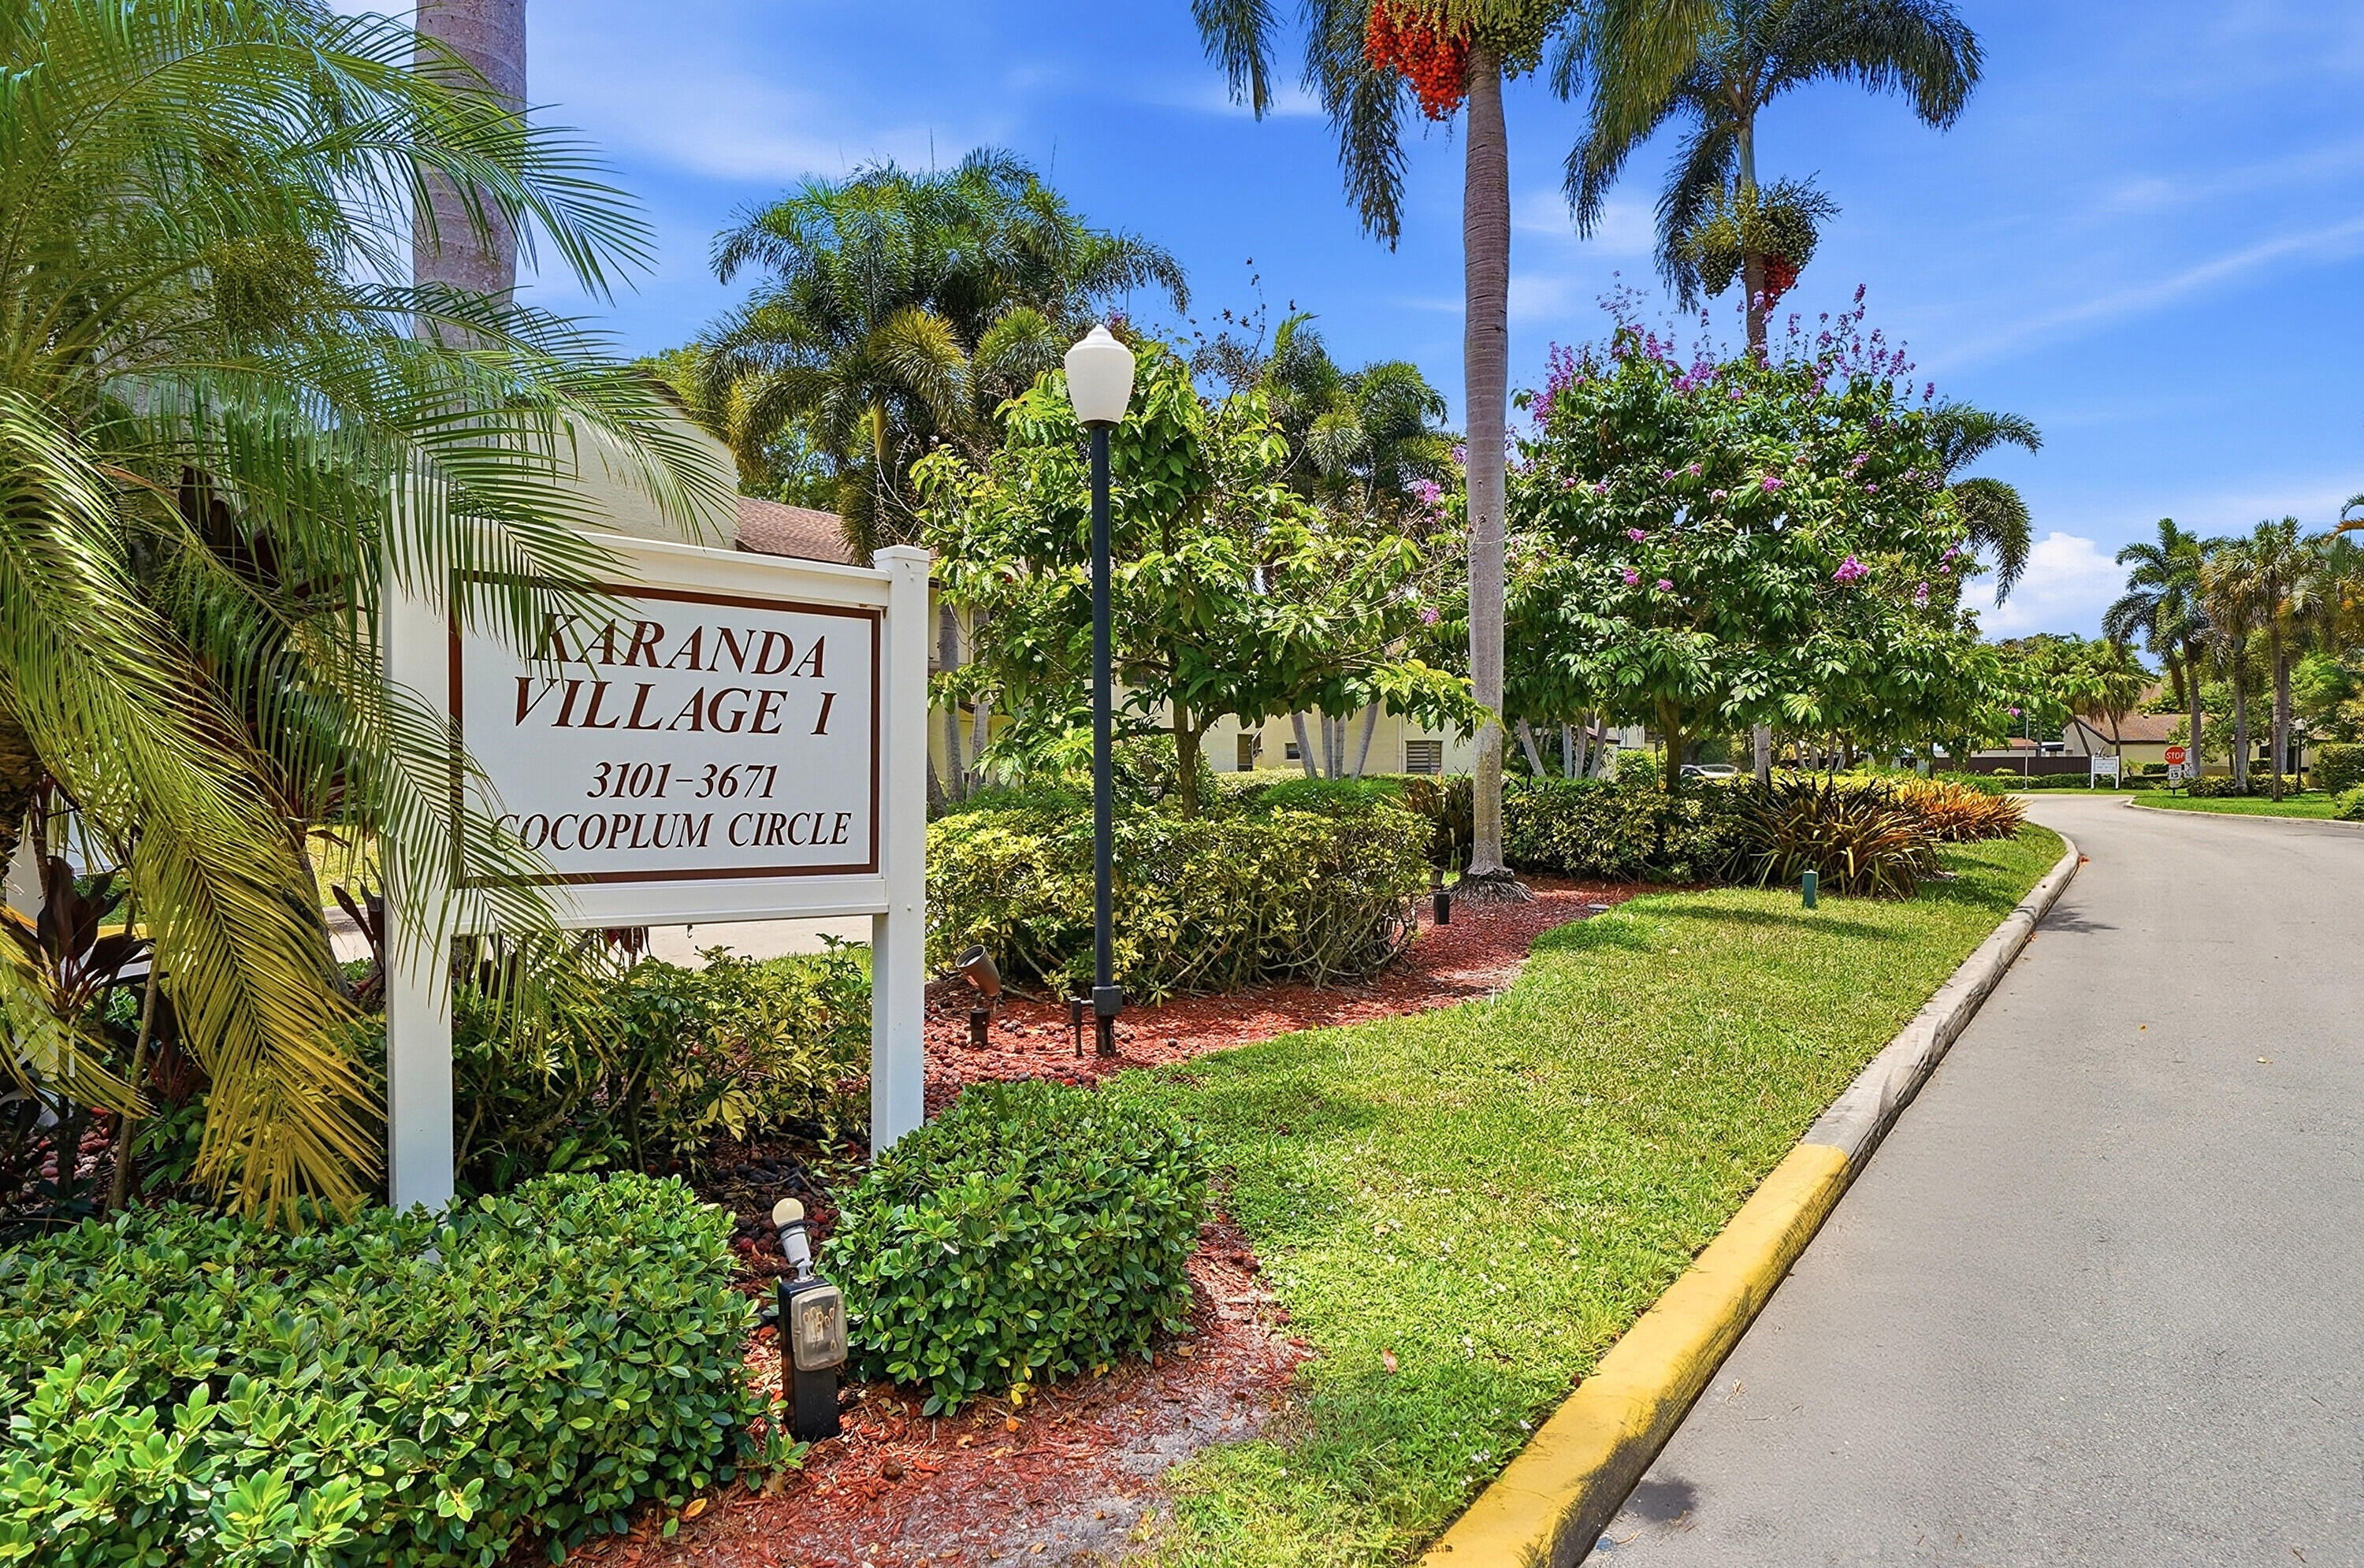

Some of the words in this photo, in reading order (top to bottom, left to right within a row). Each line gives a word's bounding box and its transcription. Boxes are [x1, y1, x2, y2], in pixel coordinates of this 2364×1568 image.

[527, 612, 825, 678] KARANDA
[515, 676, 788, 734] VILLAGE
[810, 691, 837, 735] I
[586, 762, 778, 798] 3101-3671
[490, 813, 714, 851] COCOPLUM
[728, 812, 852, 846] CIRCLE
